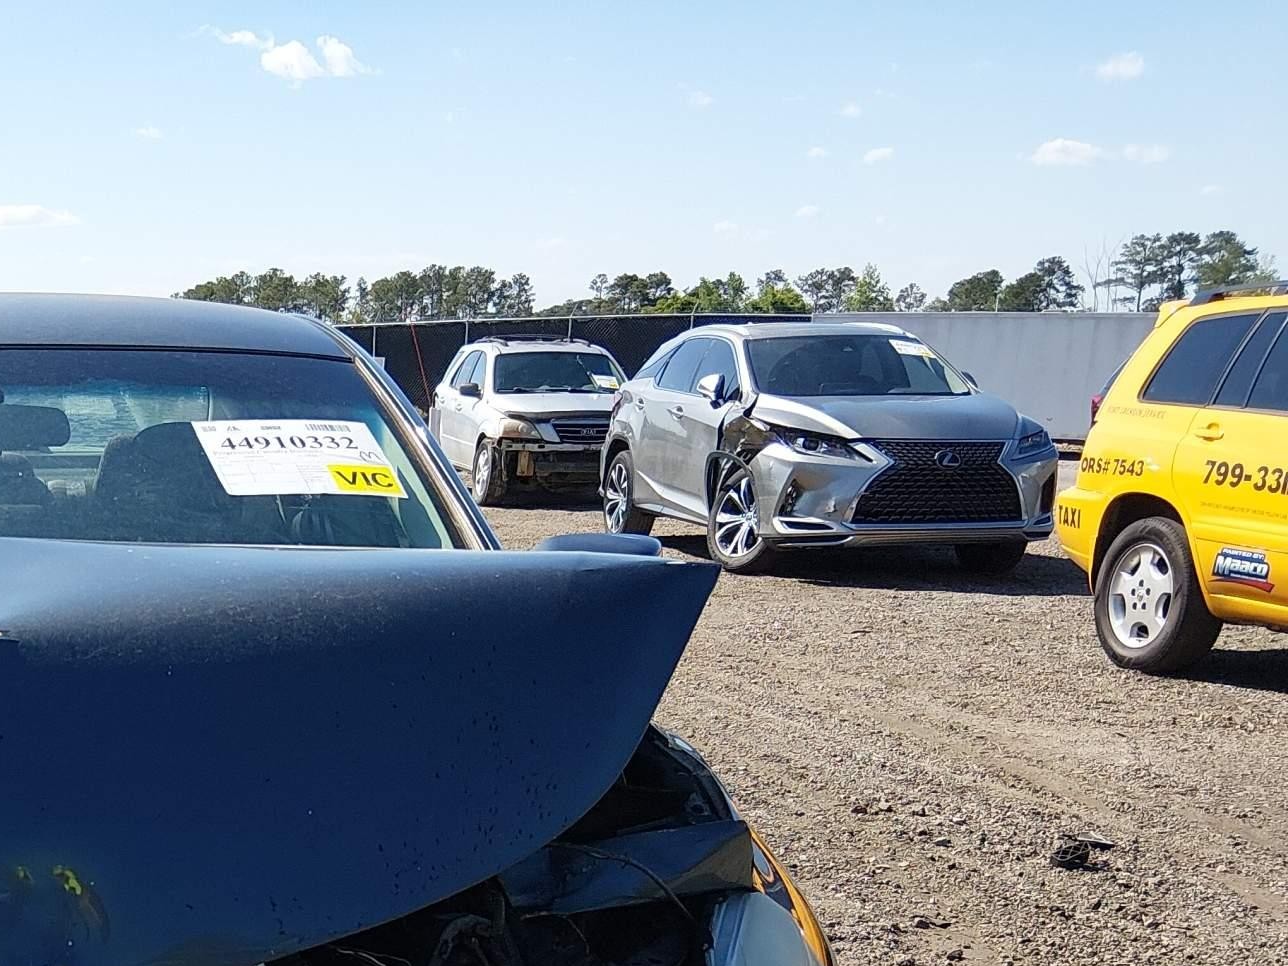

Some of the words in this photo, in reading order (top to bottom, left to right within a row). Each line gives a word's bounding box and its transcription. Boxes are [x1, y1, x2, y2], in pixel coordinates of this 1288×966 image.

[220, 434, 358, 450] 44910332
[1081, 457, 1110, 475] ORS#
[1112, 459, 1145, 477] 7543
[335, 471, 394, 487] VIC
[1058, 505, 1081, 529] TAXI
[1222, 548, 1252, 558] PAINTED
[1214, 555, 1269, 576] Maaco
